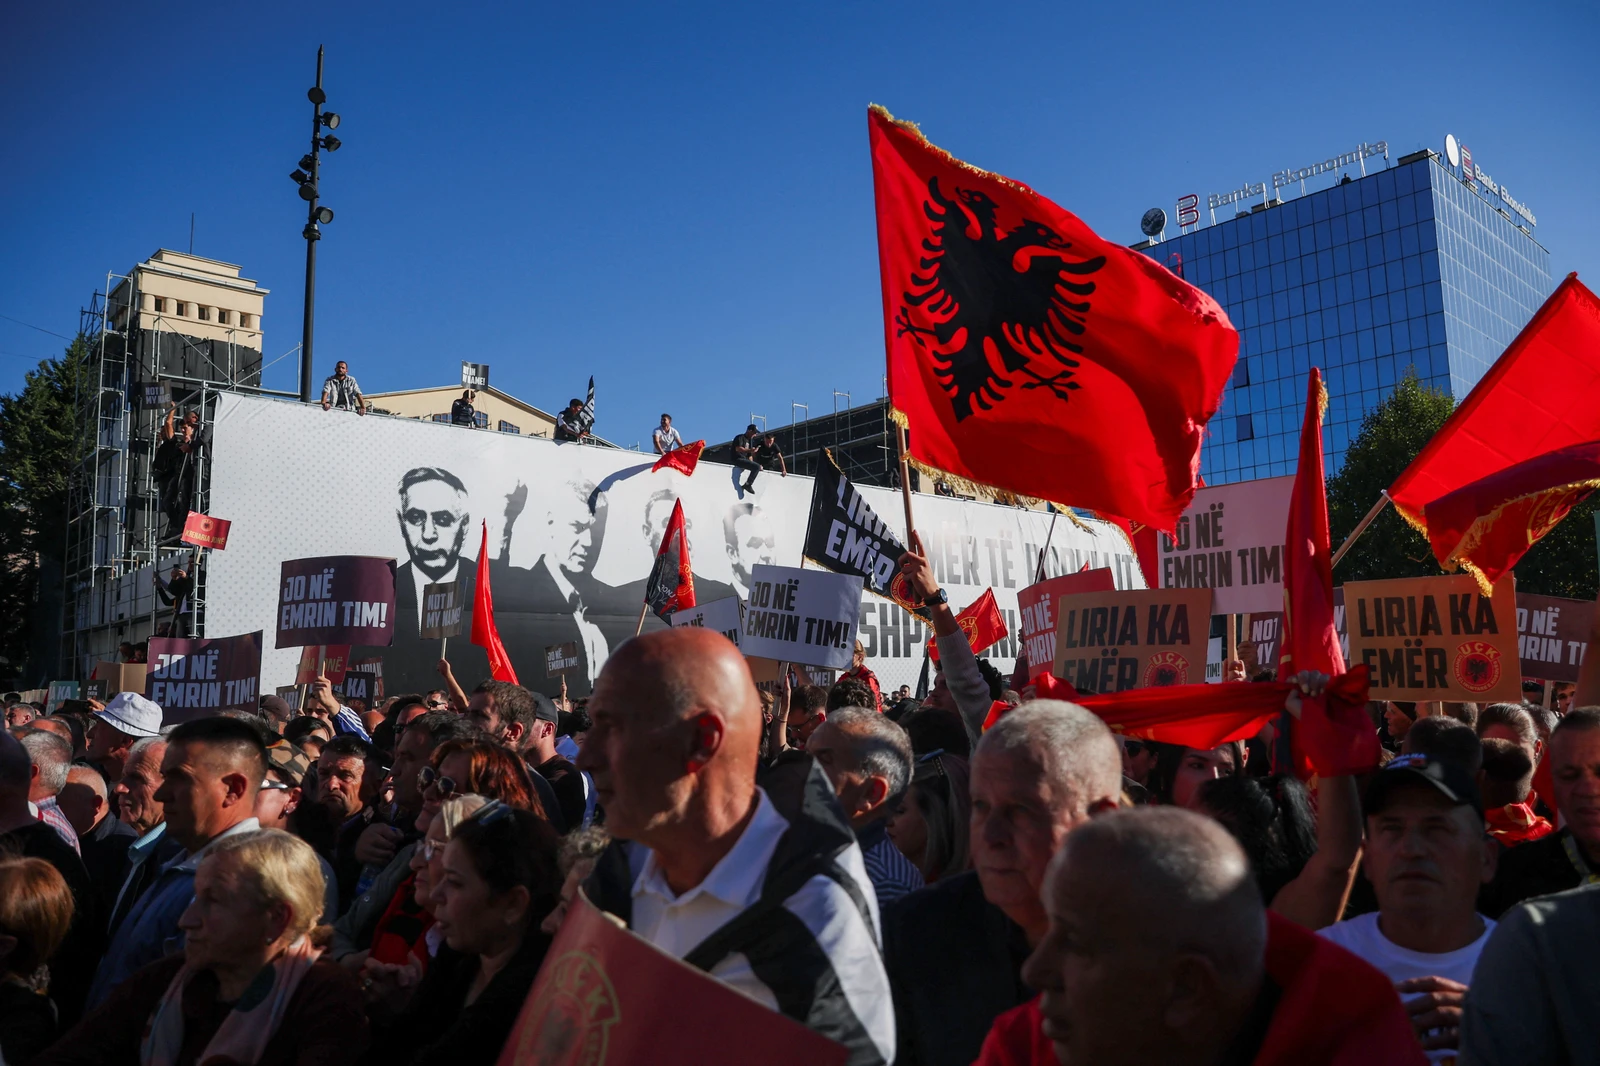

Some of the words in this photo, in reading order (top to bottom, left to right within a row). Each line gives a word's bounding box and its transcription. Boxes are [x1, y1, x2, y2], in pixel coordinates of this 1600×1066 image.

[1207, 182, 1266, 210] Banka
[1271, 140, 1389, 189] Ekonomike
[1475, 163, 1499, 195] Banka
[1501, 185, 1537, 227] Ekonomike
[1195, 502, 1225, 549] NË
[903, 519, 982, 587] MËR
[985, 528, 1017, 589] TË
[1163, 550, 1233, 588] EMRIN
[283, 575, 306, 602] JO
[308, 567, 335, 600] NË
[751, 581, 771, 608] JO
[772, 578, 800, 612] NË
[280, 601, 337, 631] EMRIN
[342, 601, 388, 629] TIM!
[427, 593, 446, 611] NOT
[1022, 605, 1035, 637] JO
[1034, 593, 1054, 632] NË
[1357, 595, 1443, 637] LIRIA
[1448, 593, 1499, 636] KA
[426, 609, 441, 629] MY
[746, 609, 800, 642] EMRIN
[804, 616, 851, 650] TIM!
[1066, 605, 1139, 649] LIRIA
[1147, 604, 1191, 646] KA
[1516, 607, 1529, 632] O
[1531, 606, 1561, 637] NË
[154, 654, 186, 680] JO
[190, 649, 220, 680] NË
[316, 656, 343, 672] ONË
[1152, 652, 1187, 670] UÇK
[1362, 638, 1449, 688] EMËR
[1459, 642, 1498, 660] UÇK
[1518, 634, 1563, 664] MRIN
[1567, 640, 1588, 666] TI
[809, 671, 831, 687] AME!
[1062, 648, 1139, 694] EMËR
[1207, 662, 1221, 678] TIM!
[57, 686, 72, 700] KA
[152, 681, 222, 708] EMRIN
[225, 676, 256, 706] TIM!
[346, 678, 367, 698] KA
